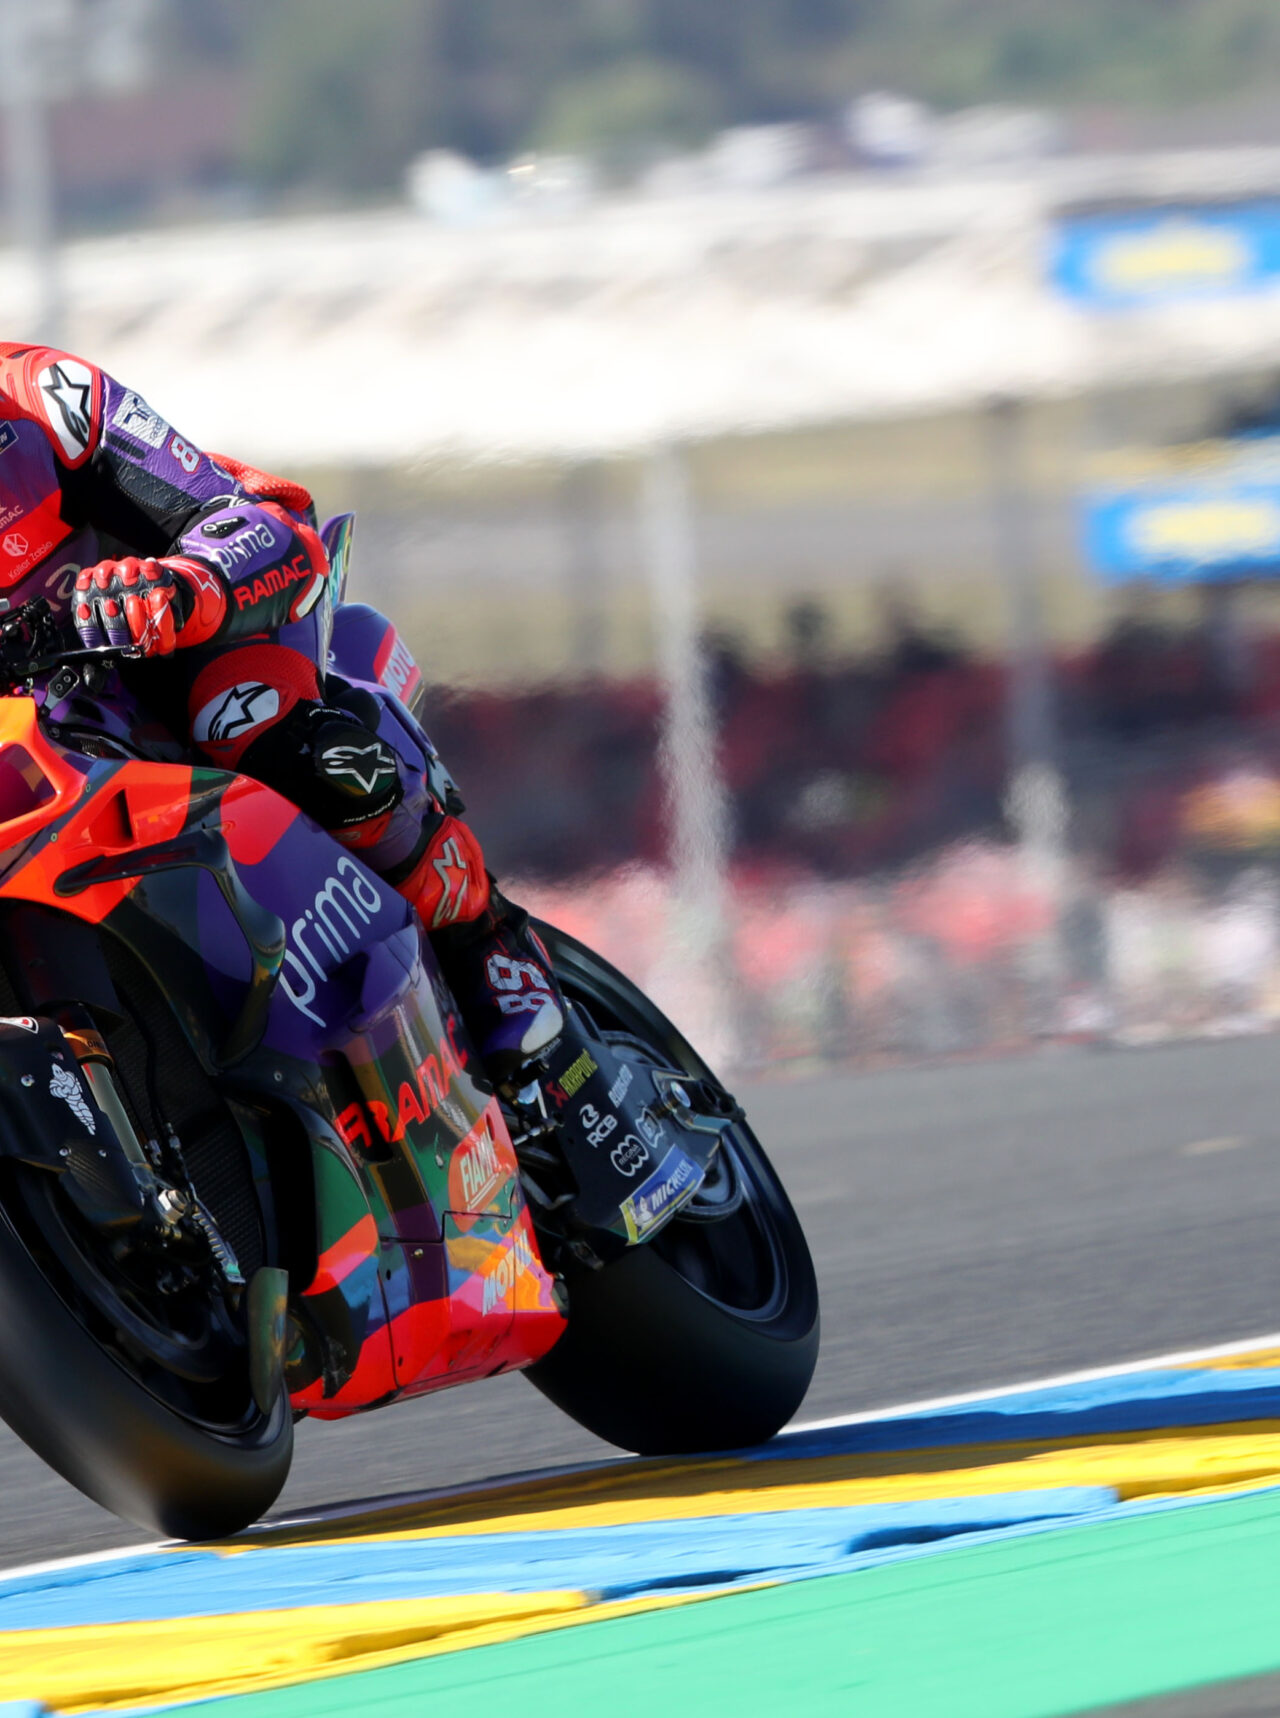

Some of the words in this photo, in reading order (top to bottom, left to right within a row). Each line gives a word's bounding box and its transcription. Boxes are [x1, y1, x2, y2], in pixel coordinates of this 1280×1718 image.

[209, 522, 276, 580] prima
[278, 856, 383, 1028] prima
[586, 1114, 618, 1148] RCB
[651, 1159, 693, 1211] MICHELIN
